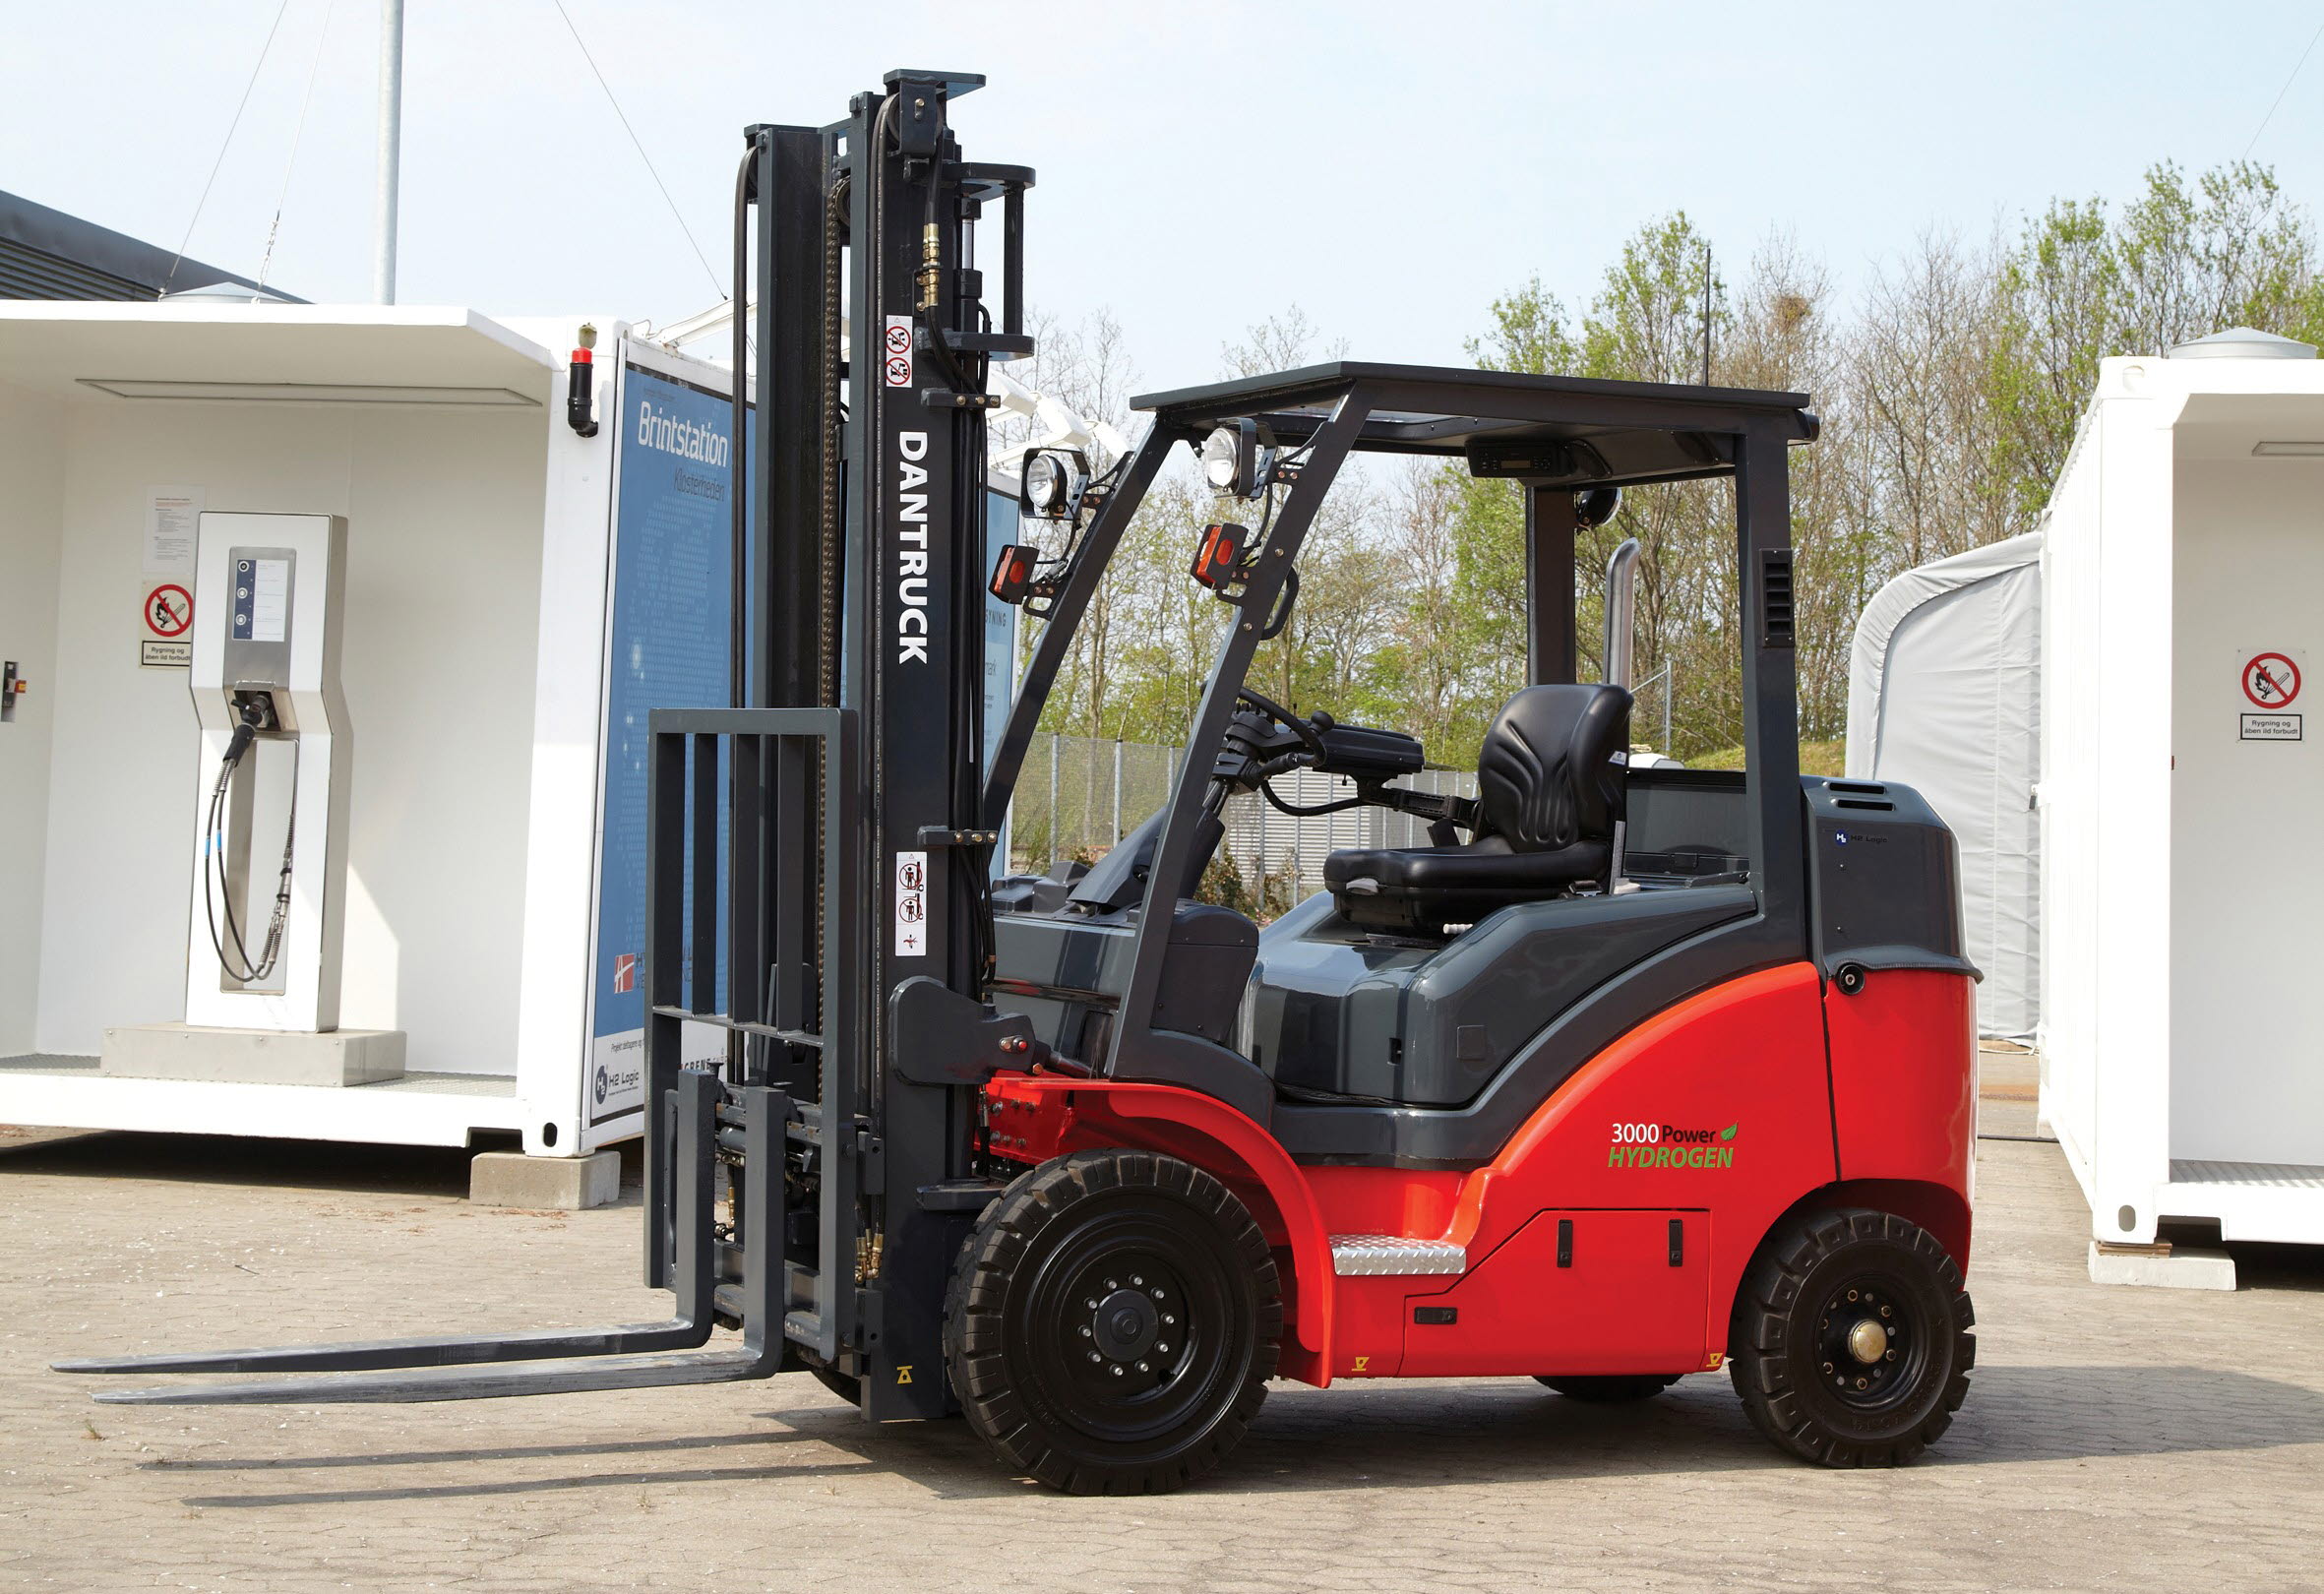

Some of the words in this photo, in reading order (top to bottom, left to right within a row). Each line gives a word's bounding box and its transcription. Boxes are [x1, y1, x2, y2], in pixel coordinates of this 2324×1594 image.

[638, 400, 728, 467] Brintstation
[898, 431, 928, 665] DANTRUCK
[2251, 719, 2281, 728] Rygning
[1865, 835, 1888, 845] Logic
[608, 1073, 620, 1088] H2
[621, 1069, 640, 1086] Logic
[1611, 1123, 1660, 1143] 3000
[1662, 1125, 1716, 1143] Power
[1607, 1146, 1734, 1168] HYDROGEN
